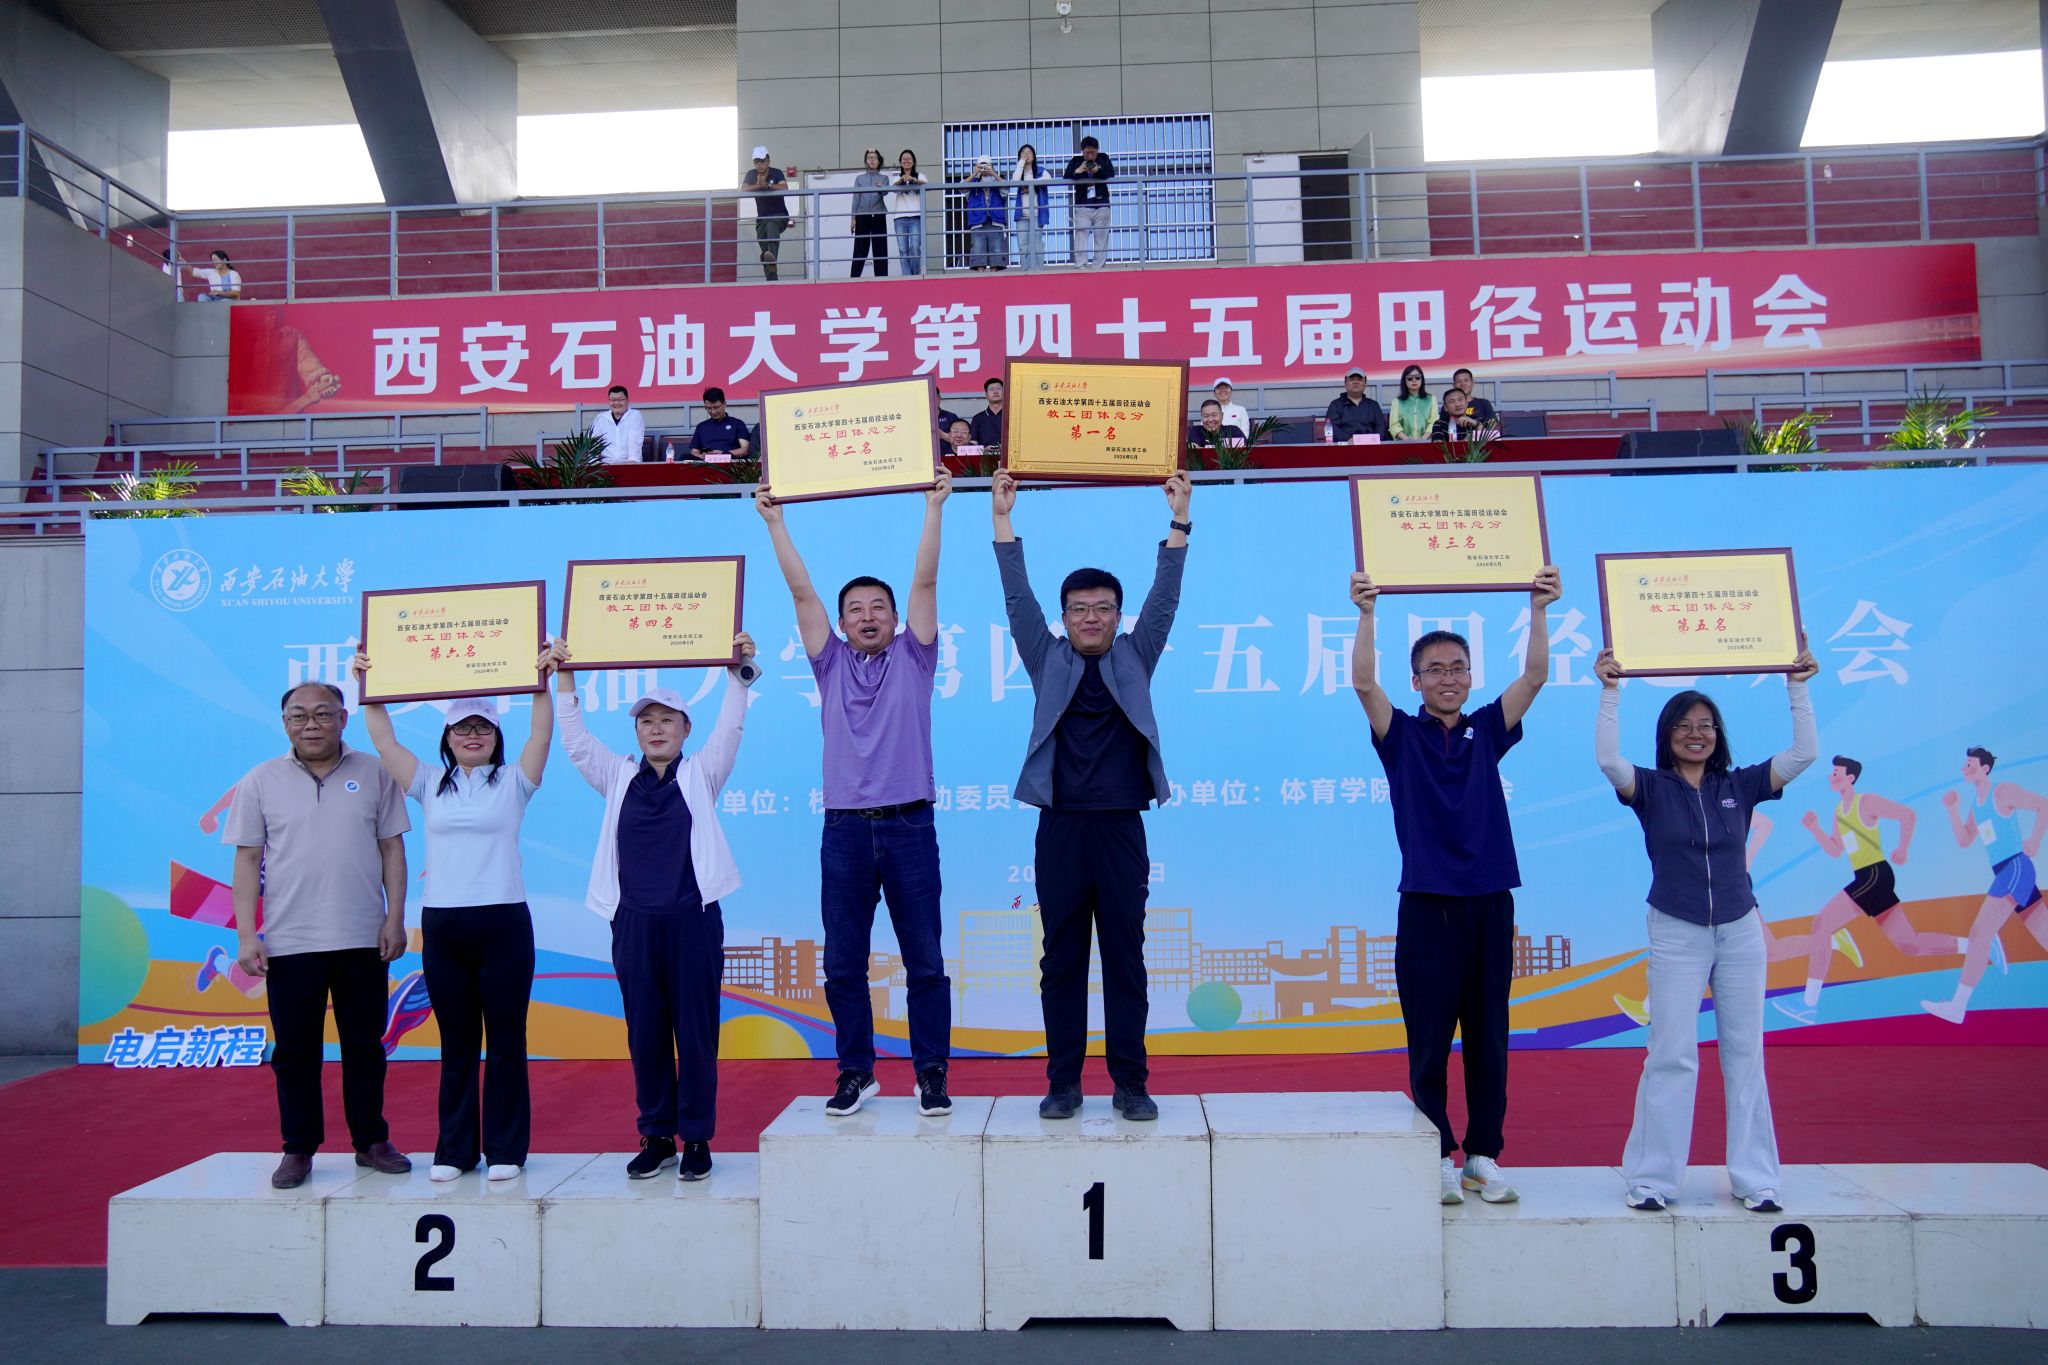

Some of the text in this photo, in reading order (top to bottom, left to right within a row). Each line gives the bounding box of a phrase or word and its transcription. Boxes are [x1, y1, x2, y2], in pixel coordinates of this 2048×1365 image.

[372, 273, 1827, 396] 西安石油大学第四十五届田径运动会
[1038, 397, 1151, 408] 西安石油大学第四十五届田径运动会
[794, 413, 902, 431] 西安石油大学第四十五届田径运动会
[1047, 409, 1144, 421] 教工团体总分
[803, 425, 896, 442] 教工团体总分
[1071, 425, 1117, 440] 第一名
[828, 441, 873, 460] 第二名
[1390, 508, 1508, 519] 西安石油大学第四十五届田径运动会
[1400, 521, 1502, 531] 教工团体总分
[1428, 535, 1477, 551] 第三名
[251, 597, 291, 607] SHIYOU
[293, 596, 354, 605] UNIVERSITY
[599, 591, 708, 601] 西安石油大学第四十五届田径运动会
[1639, 590, 1759, 601] 西安石油大学第四十五届田径运动会
[606, 602, 701, 613] 教工团体总分
[1649, 602, 1753, 613] 教工团体总分
[397, 617, 509, 632] 西安石油大学第四十五届田径运动会
[629, 616, 673, 630] 第四名
[1677, 617, 1727, 634] 第五名
[405, 630, 503, 643] 教工团体总分
[430, 644, 477, 661] 第六名
[105, 1026, 267, 1067] 电启新程
[1083, 1182, 1105, 1260] 1
[415, 1213, 455, 1291] 2
[1771, 1223, 1817, 1304] 3
